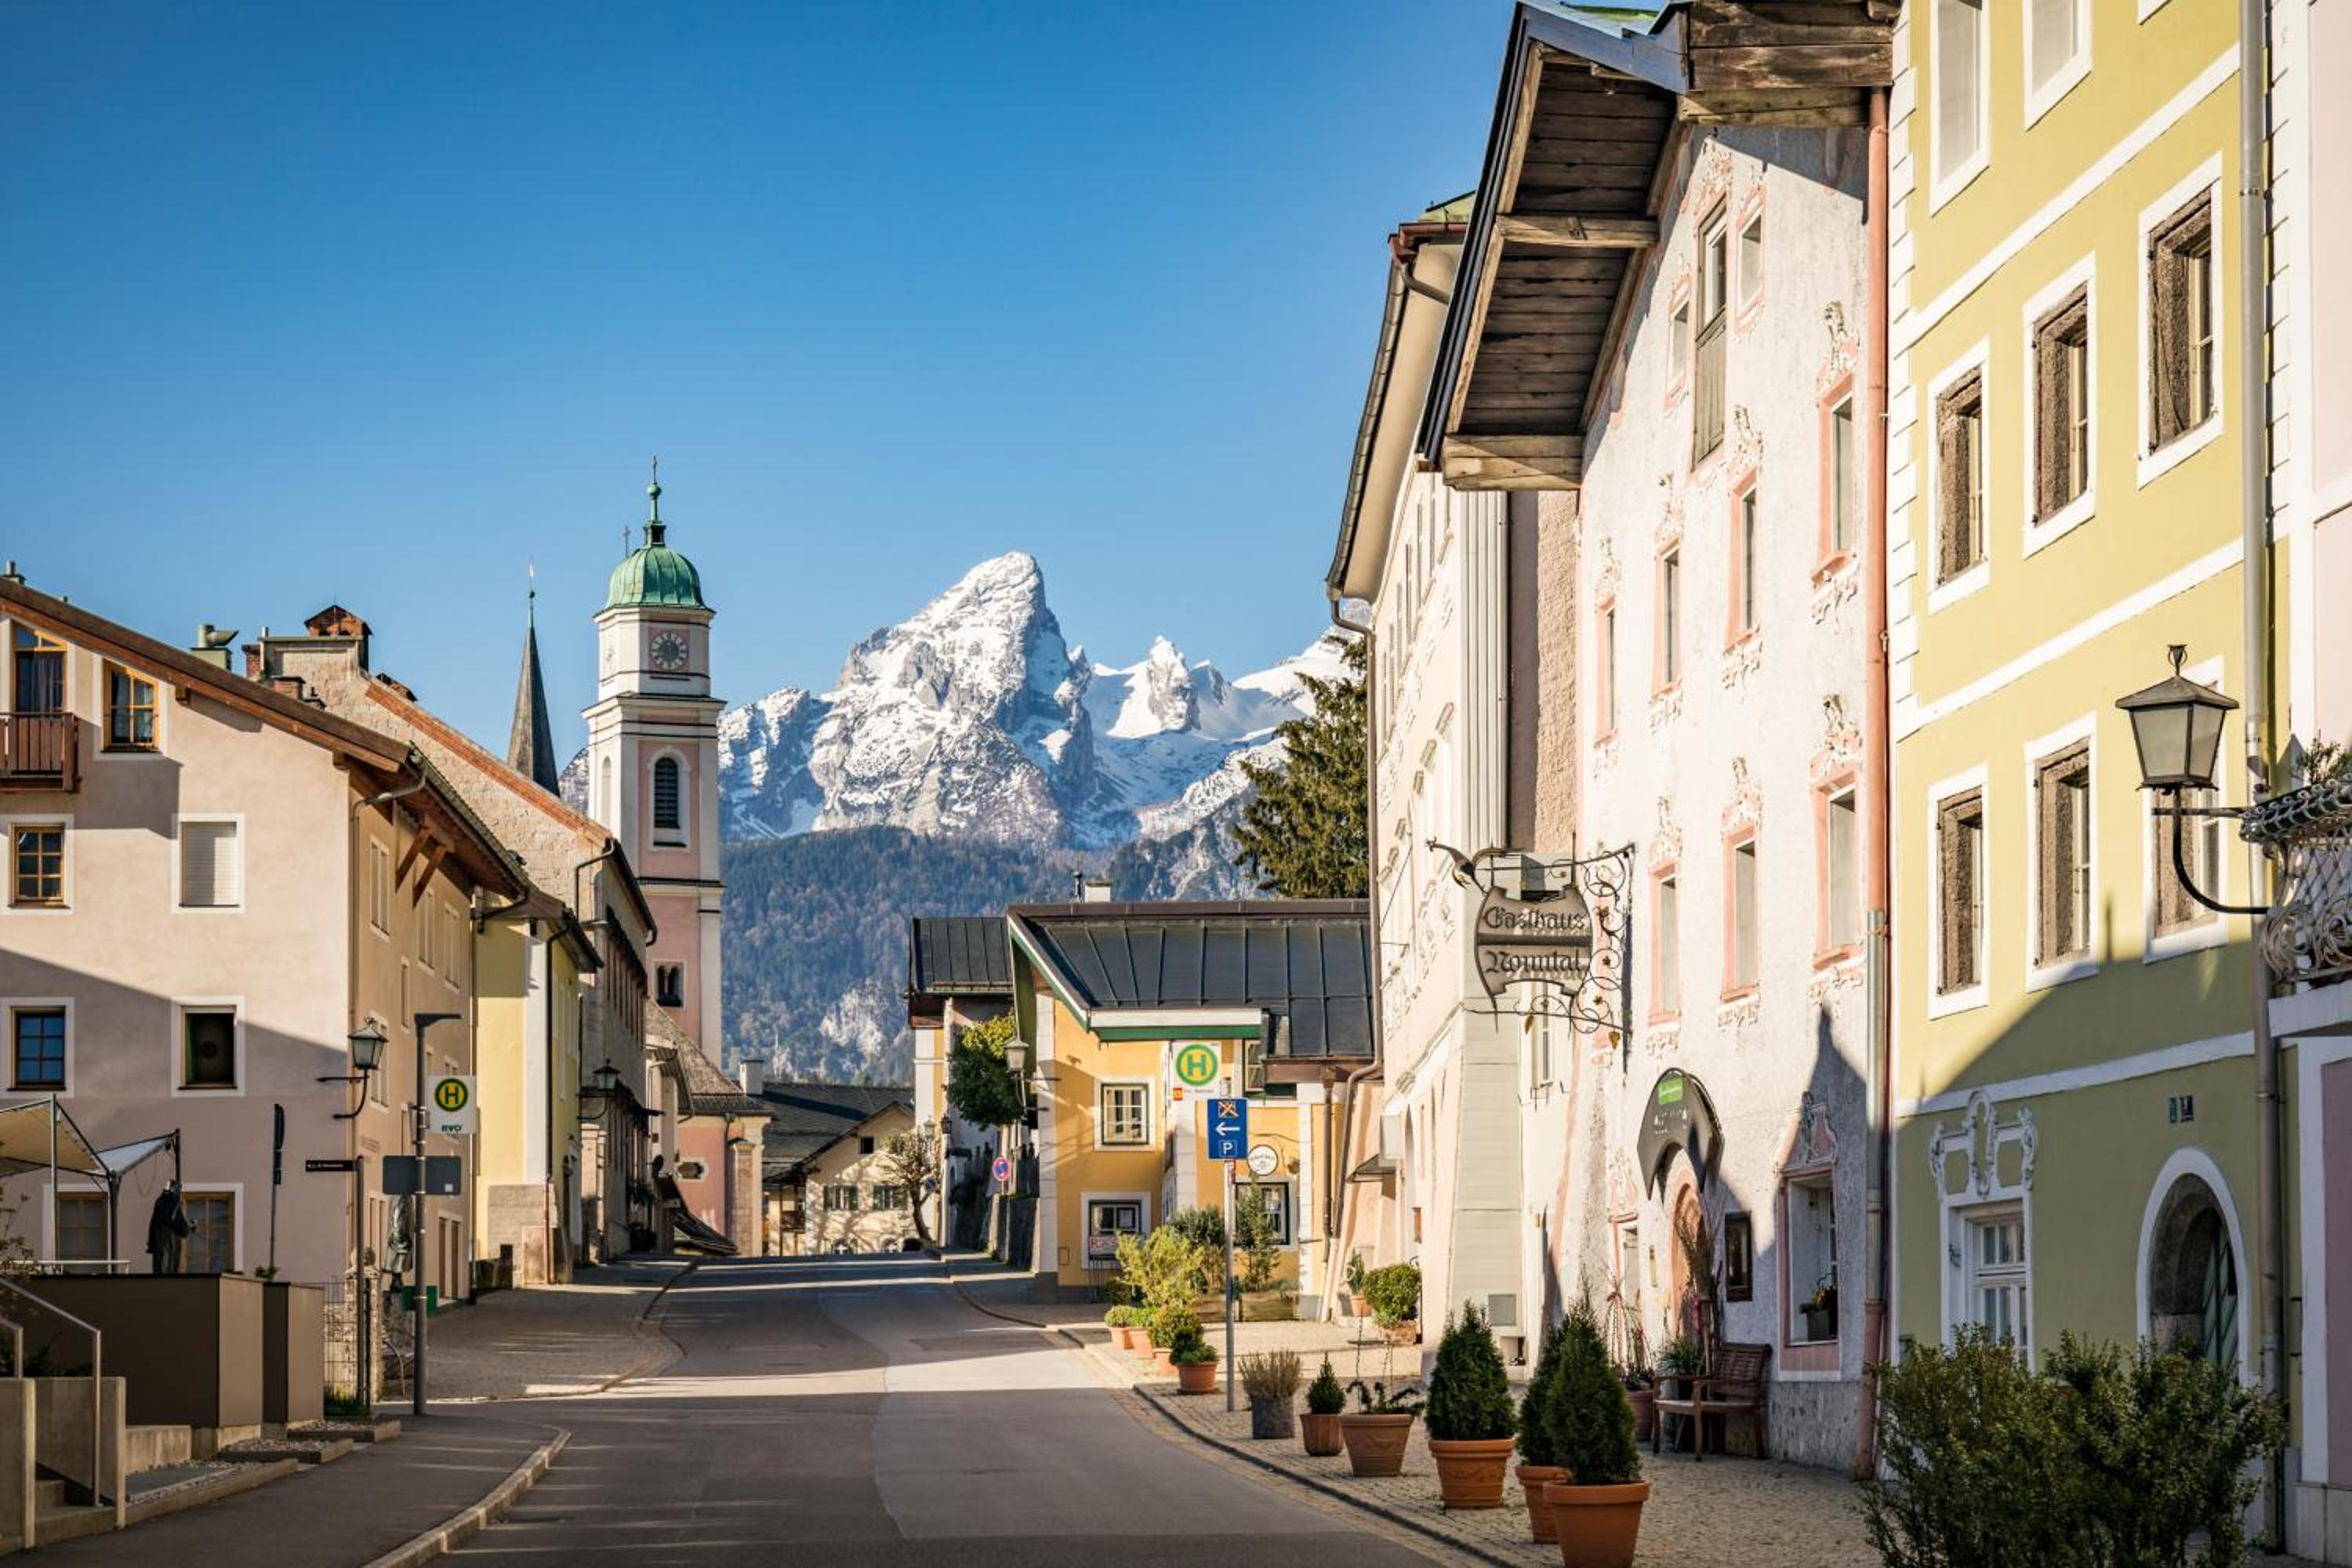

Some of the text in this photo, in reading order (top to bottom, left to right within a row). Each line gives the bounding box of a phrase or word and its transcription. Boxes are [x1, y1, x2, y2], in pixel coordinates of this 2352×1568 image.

[1484, 906, 1585, 930] Gasthaus
[1485, 949, 1581, 973] Nonntal
[1187, 1053, 1207, 1076] H
[445, 1086, 459, 1104] H
[1224, 1142, 1233, 1155] P
